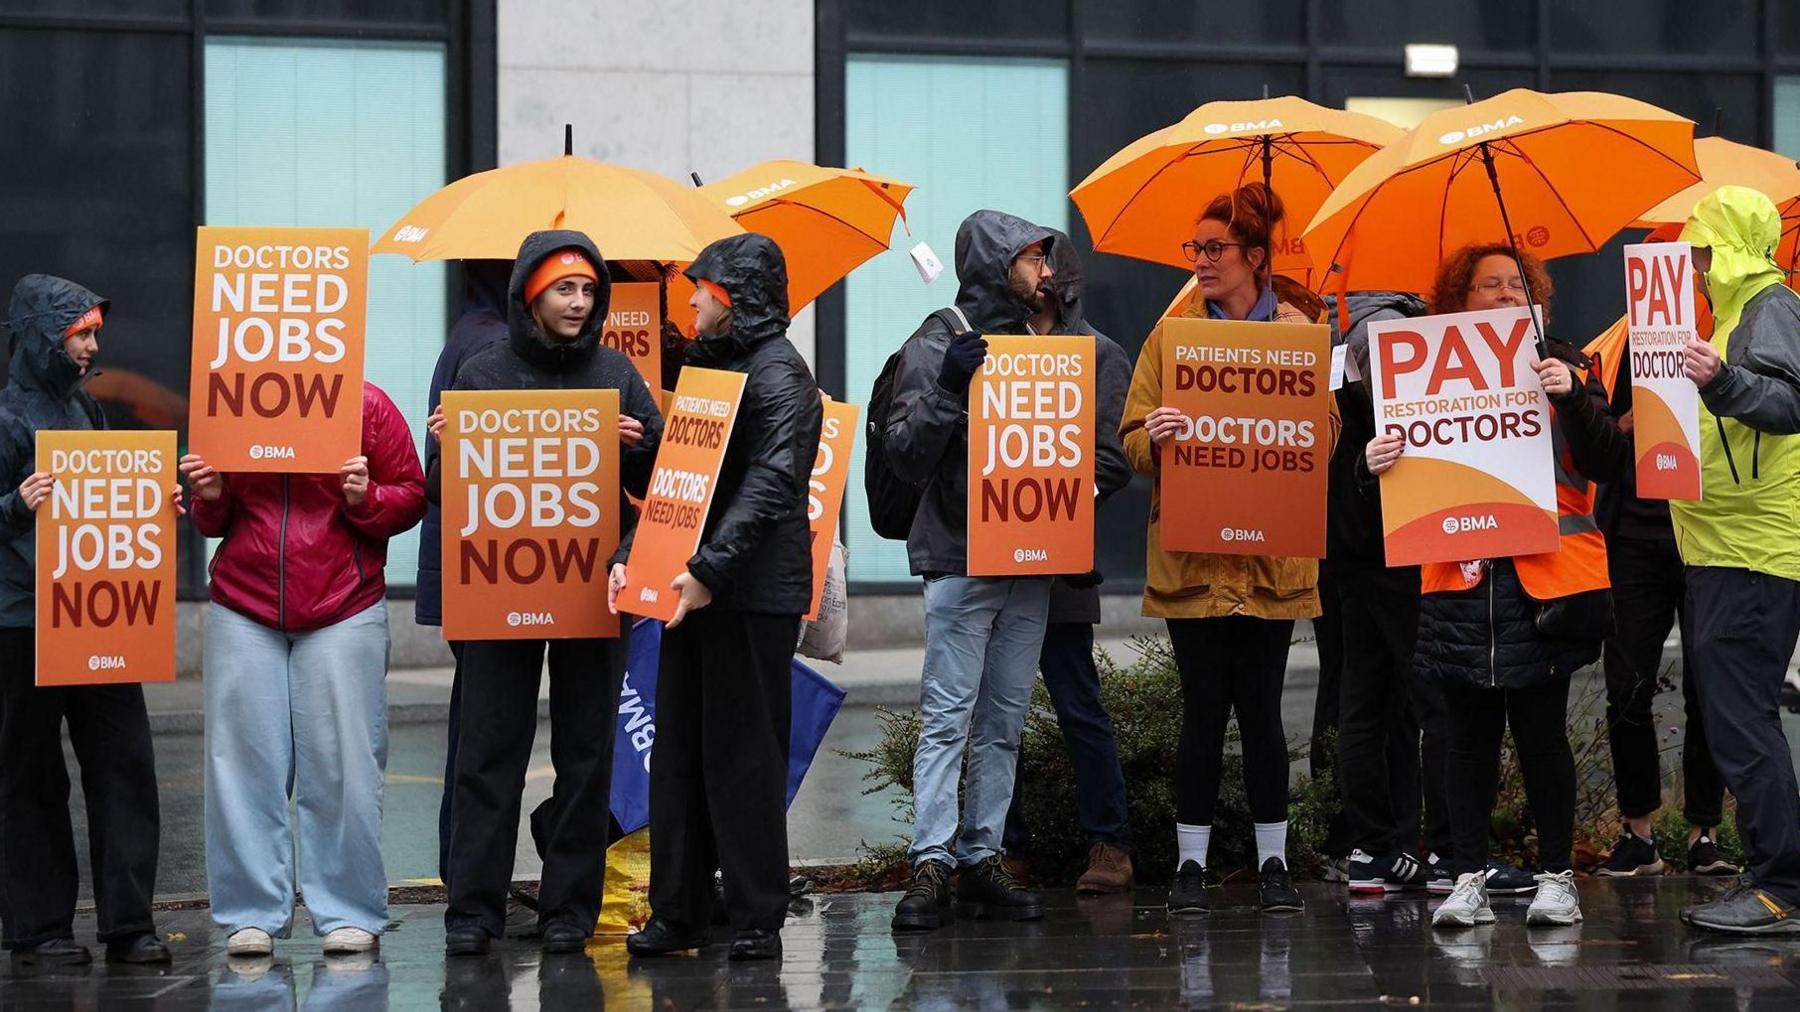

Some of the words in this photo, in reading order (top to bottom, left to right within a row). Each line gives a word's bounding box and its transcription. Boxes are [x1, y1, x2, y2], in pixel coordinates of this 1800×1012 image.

[1231, 118, 1284, 132] BMA
[1466, 114, 1523, 139] BMA
[746, 178, 797, 200] BMA
[213, 245, 350, 270] DOCTORS
[210, 273, 348, 313] NEED
[1628, 254, 1686, 327] PAY
[610, 311, 650, 328] NEED
[210, 317, 347, 369] JOBS
[1632, 331, 1677, 346] RESTORATION
[1678, 330, 1691, 344] FOR
[983, 353, 1082, 376] DOCTORS
[1175, 345, 1262, 364] PATIENTS
[1266, 349, 1317, 366] NEED
[1378, 318, 1532, 400] PAY
[1633, 351, 1686, 379] DOCTOR
[207, 372, 344, 418] NOW
[1175, 365, 1316, 397] DOCTORS
[675, 395, 709, 413] PATIENTS
[708, 402, 730, 417] NEED
[982, 381, 1082, 419] NEED
[1383, 393, 1500, 419] RESTORATION
[1505, 390, 1540, 406] FOR
[459, 408, 600, 434] DOCTORS
[666, 415, 724, 450] DOCTORS
[1175, 415, 1315, 448] DOCTORS
[1385, 409, 1542, 448] DOCTORS
[52, 449, 162, 474] DOCTORS
[264, 446, 295, 460] BMA
[459, 438, 600, 478] NEED
[982, 424, 1082, 476] JOBS
[1174, 445, 1246, 468] NEED
[1251, 449, 1314, 473] JOBS
[1663, 455, 1678, 470] BMA
[52, 478, 162, 519] NEED
[652, 468, 709, 503] DOCTORS
[981, 478, 1081, 522] NOW
[460, 482, 600, 536] JOBS
[645, 499, 674, 525] NEED
[671, 508, 700, 529] JOBS
[1461, 514, 1498, 531] BMA
[1235, 529, 1265, 542] BMA
[52, 523, 162, 580] JOBS
[460, 538, 599, 585] NOW
[1024, 549, 1048, 561] BMA
[52, 580, 161, 628] NOW
[522, 611, 554, 625] BMA
[100, 656, 126, 669] BMA
